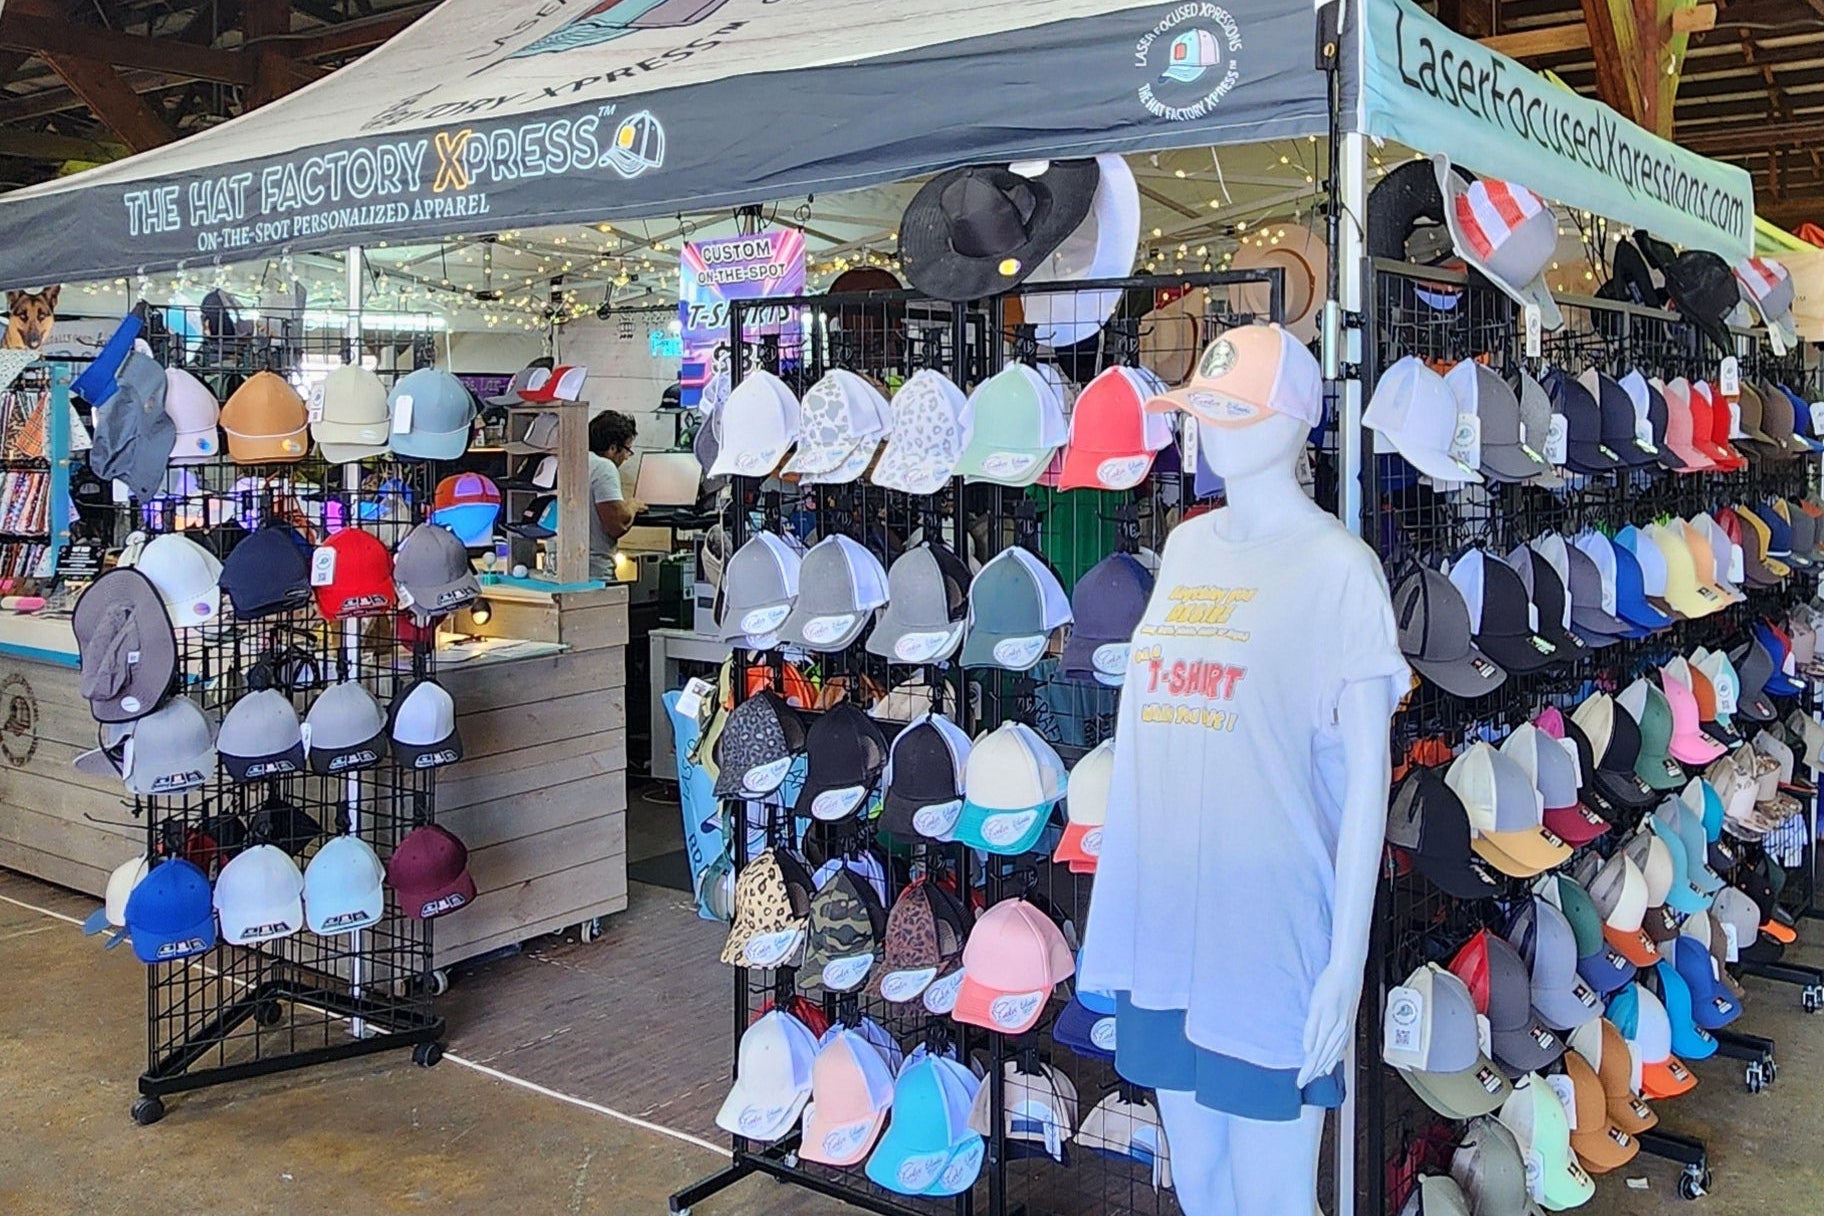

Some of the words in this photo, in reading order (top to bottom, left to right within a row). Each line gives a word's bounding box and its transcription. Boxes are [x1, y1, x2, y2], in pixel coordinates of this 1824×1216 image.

[1154, 2, 1199, 35] FOCUSED
[1145, 97, 1165, 117] HAT
[1165, 101, 1208, 121] FACTORY
[1396, 2, 1744, 238] LaserFocusedXpressions.com
[124, 185, 181, 236] THE
[189, 172, 252, 227] HAT
[261, 138, 428, 215] FACTORY
[198, 220, 291, 251] ON-THE-SPOT
[293, 202, 410, 237] PERSONALIZED
[411, 193, 490, 222] APPAREL
[702, 239, 773, 263] CUSTOM
[697, 263, 786, 284] ON-THE-SPOT
[1147, 658, 1247, 700] T-SHIRT
